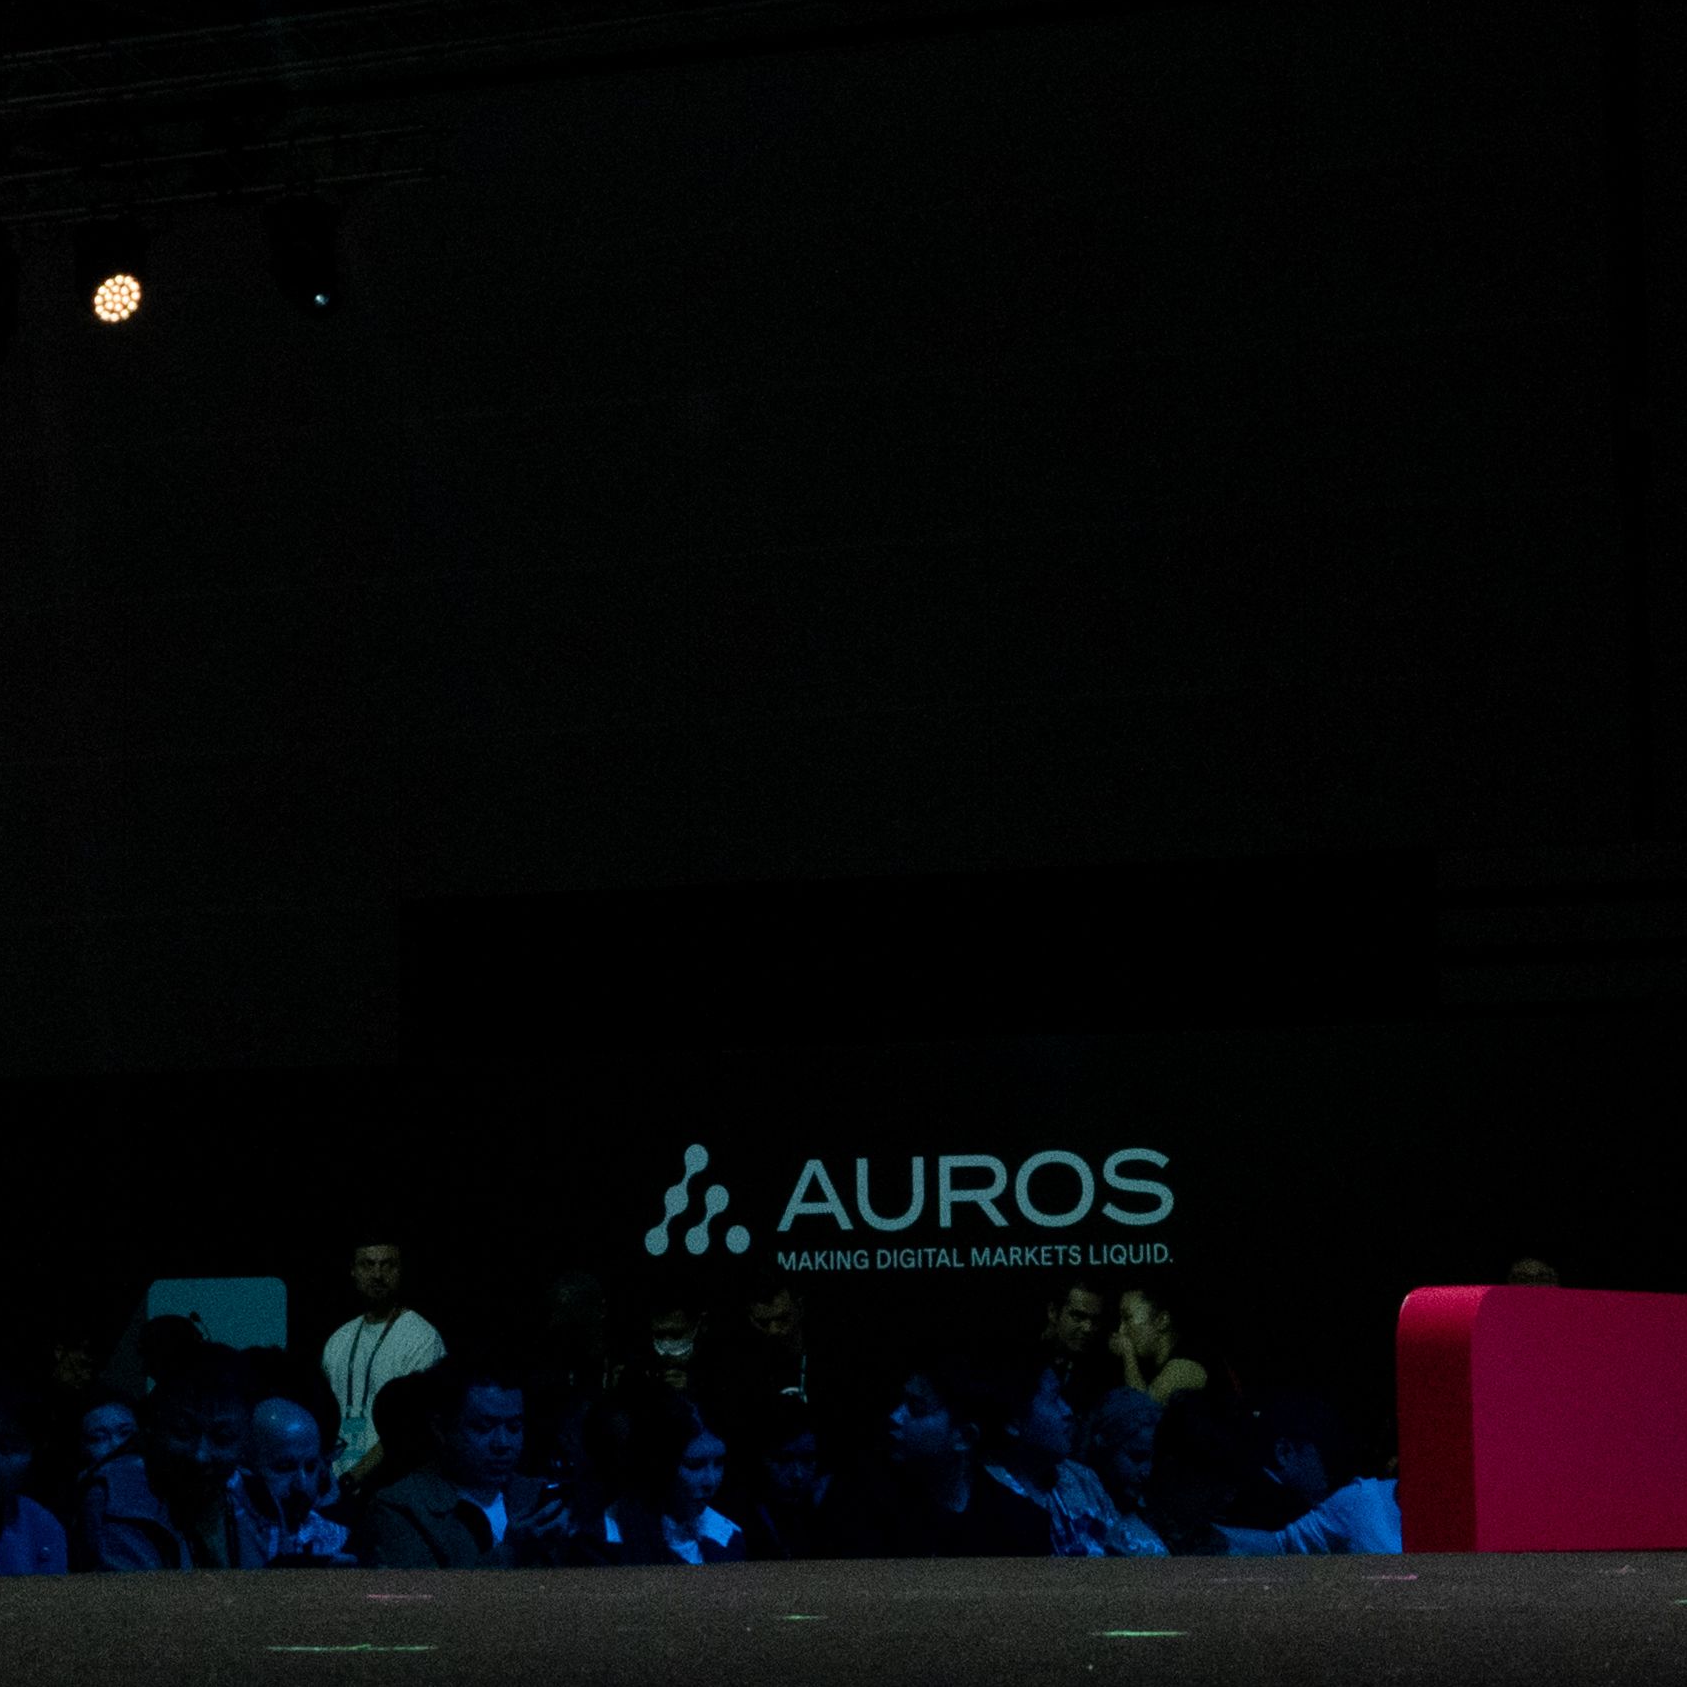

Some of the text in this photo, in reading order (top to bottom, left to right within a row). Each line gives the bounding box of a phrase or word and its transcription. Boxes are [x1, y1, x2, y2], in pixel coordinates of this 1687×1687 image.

[776, 1147, 1176, 1233] AUROS
[777, 1242, 1174, 1271] MAKING DIGITAL MARKETS LIQUID.
